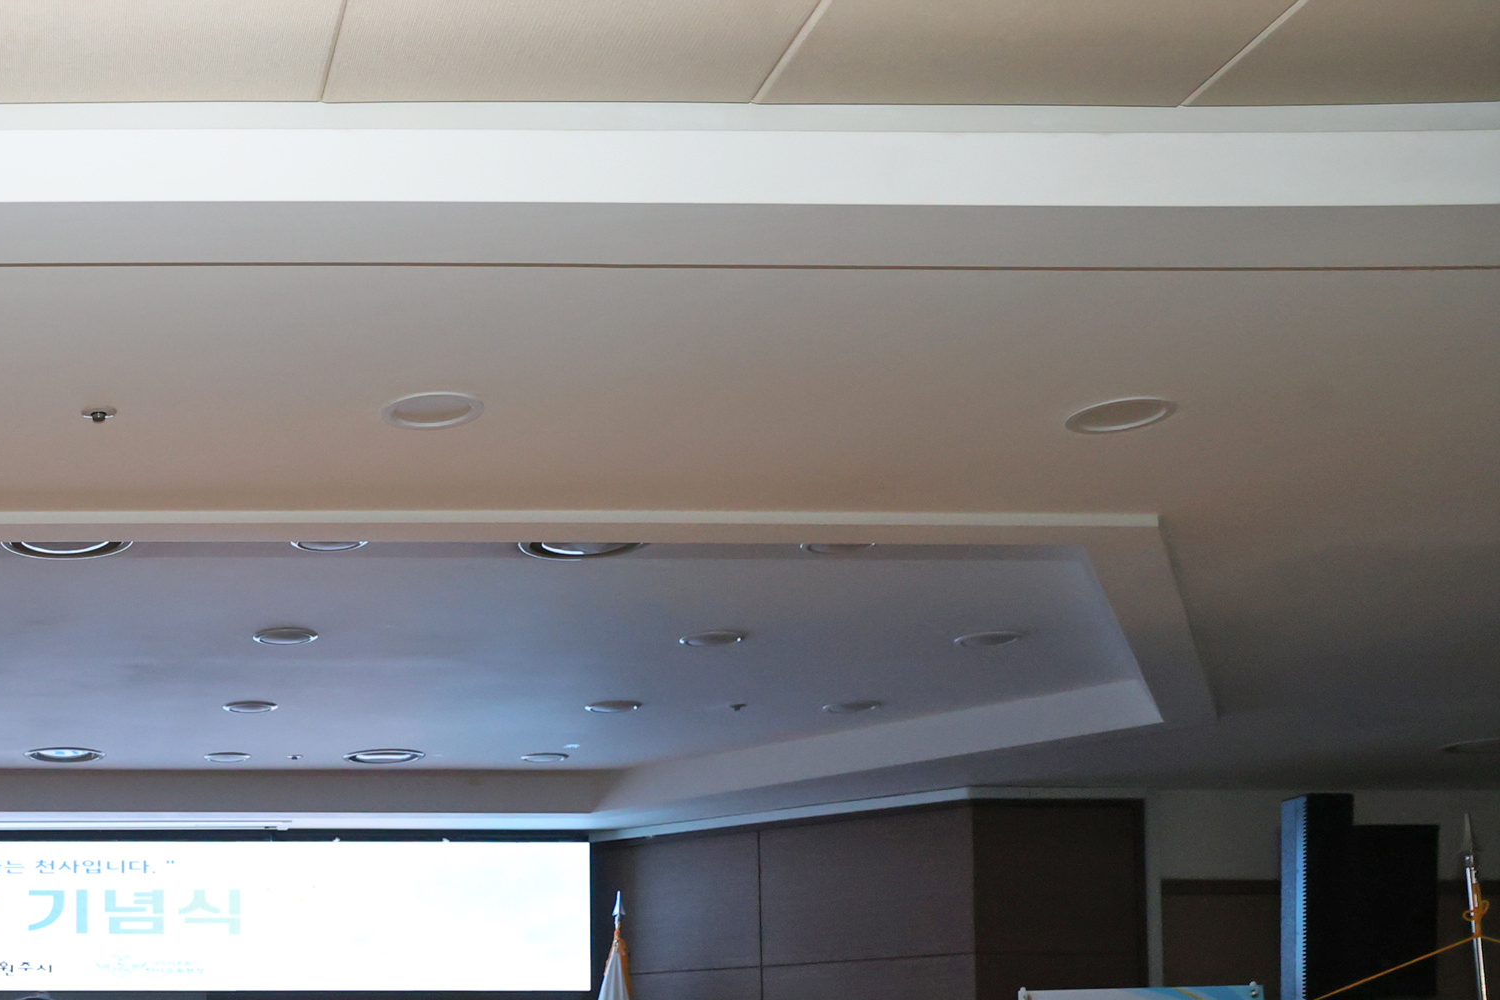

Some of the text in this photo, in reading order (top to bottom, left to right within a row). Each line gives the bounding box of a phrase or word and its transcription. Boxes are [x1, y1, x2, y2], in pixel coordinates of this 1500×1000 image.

[35, 860, 156, 874] 천사입니다.
[27, 889, 243, 936] 기념식
[0, 961, 52, 976] 원주시
